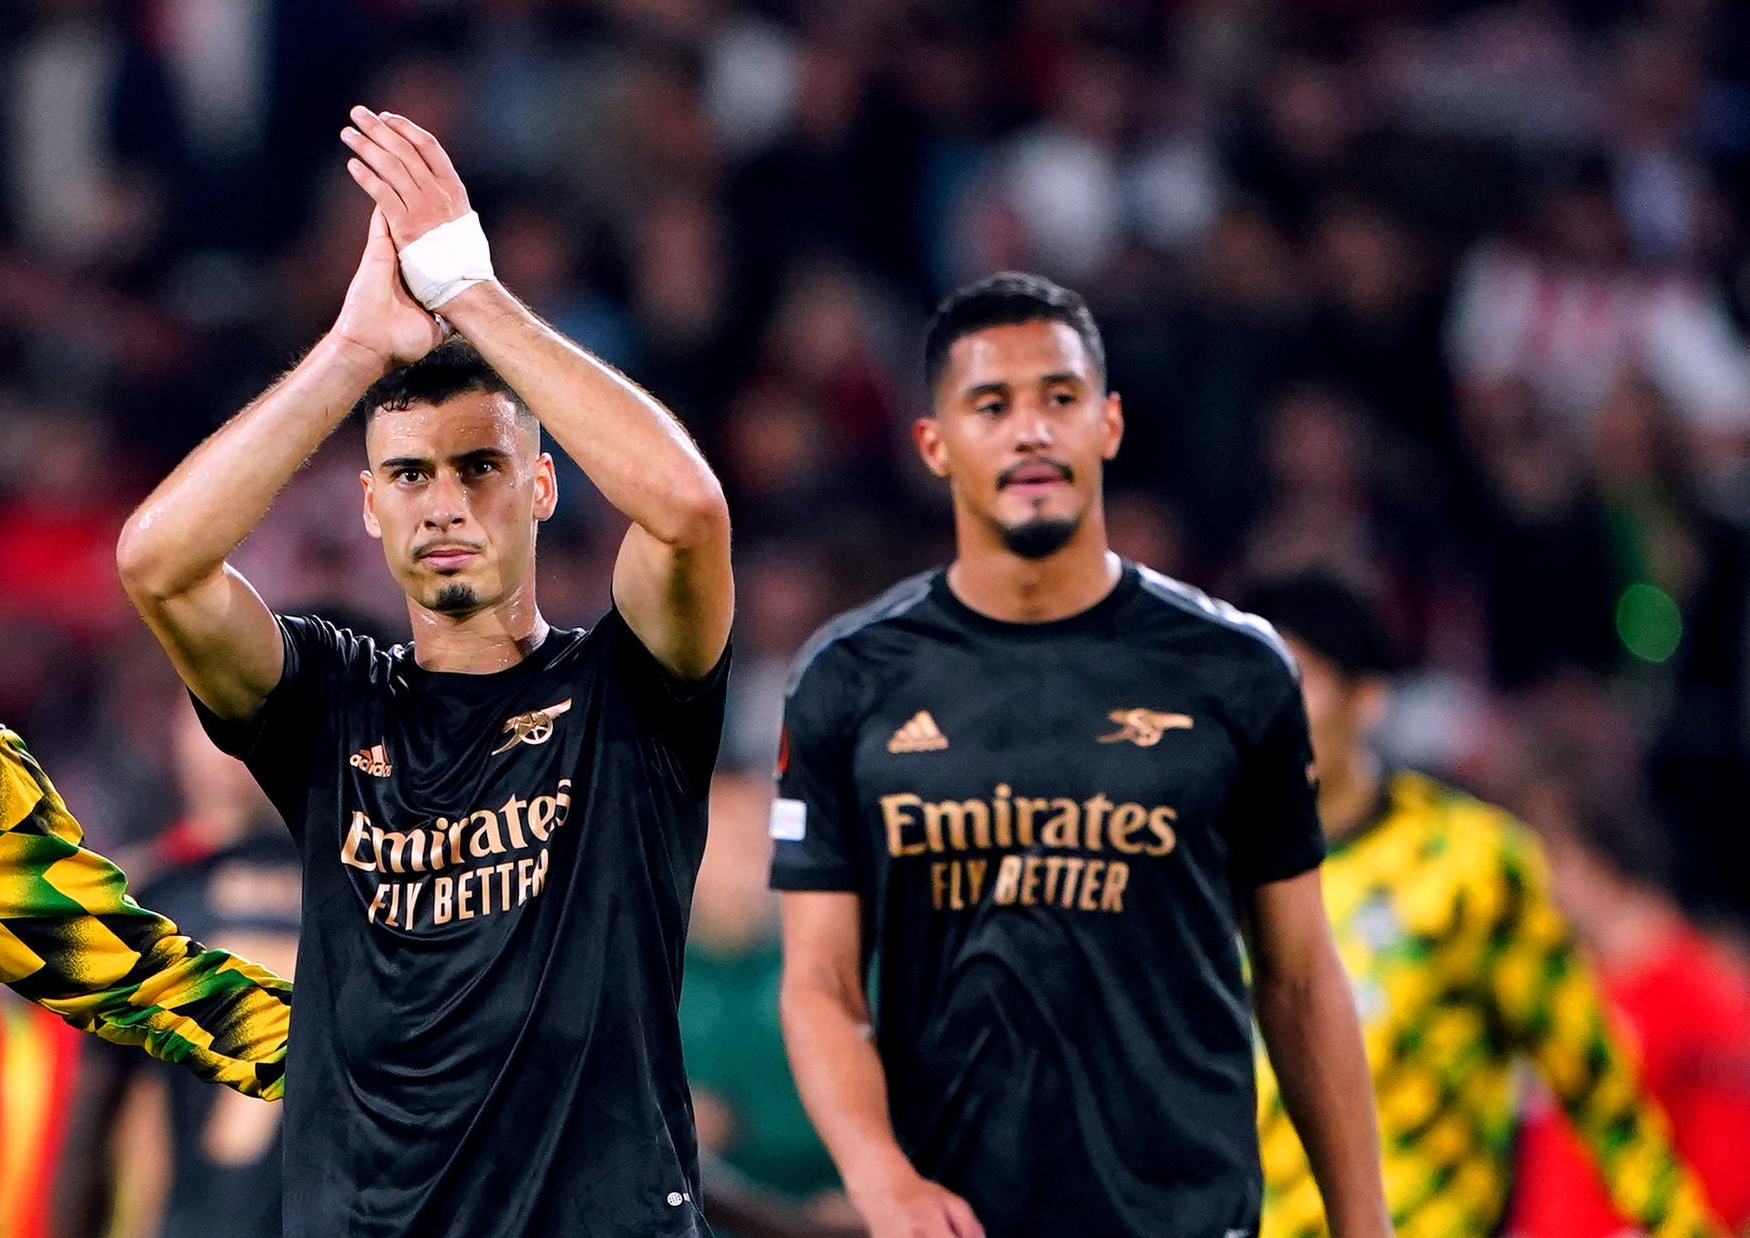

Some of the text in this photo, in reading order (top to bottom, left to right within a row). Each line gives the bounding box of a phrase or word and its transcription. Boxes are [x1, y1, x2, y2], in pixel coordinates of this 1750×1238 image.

[341, 779, 572, 873] Emirates
[879, 782, 1178, 858] Emirates
[368, 848, 548, 930] FLY BETTER
[932, 854, 1130, 912] FLY BETTER
